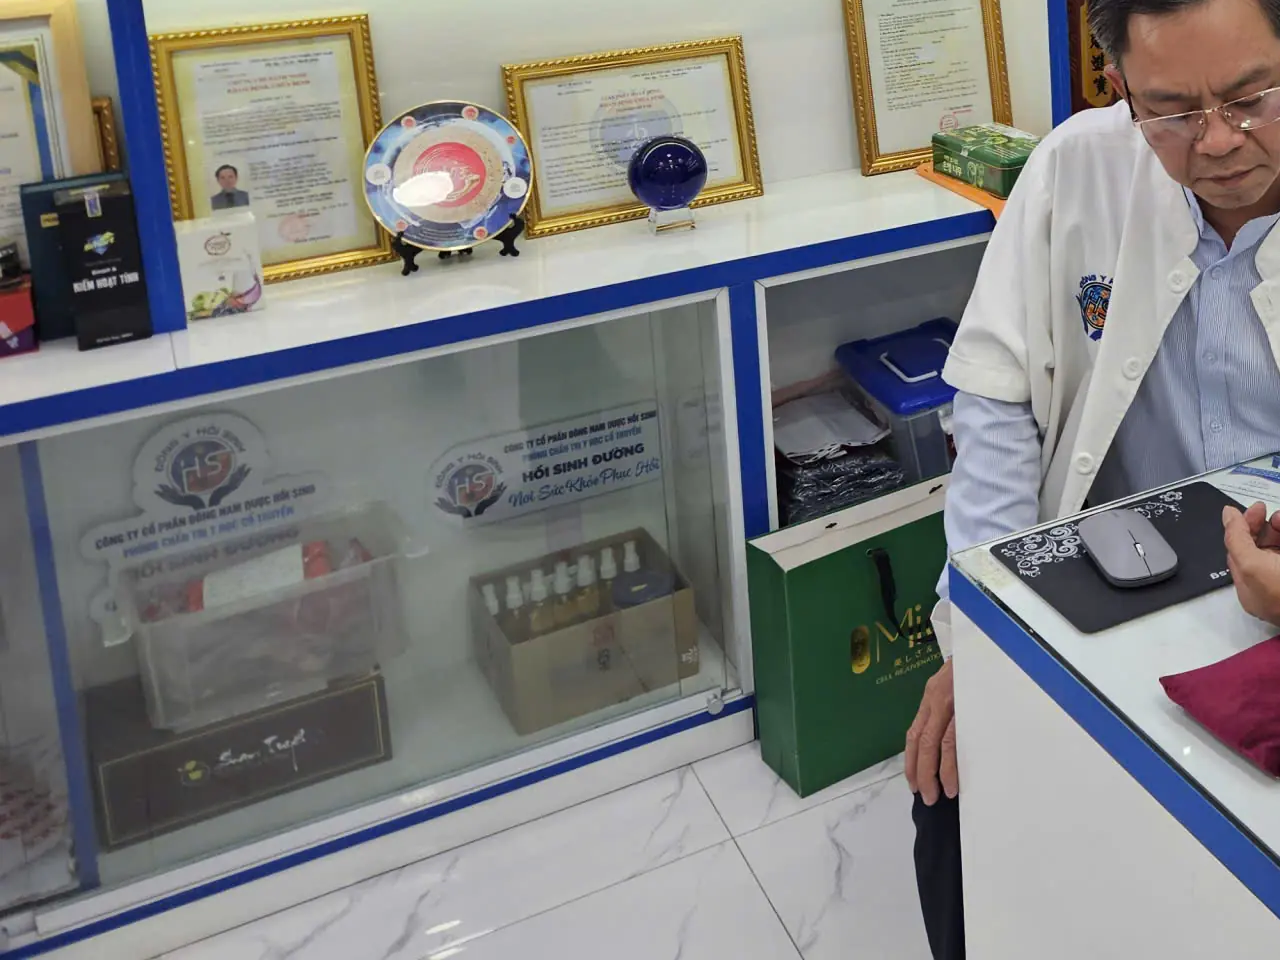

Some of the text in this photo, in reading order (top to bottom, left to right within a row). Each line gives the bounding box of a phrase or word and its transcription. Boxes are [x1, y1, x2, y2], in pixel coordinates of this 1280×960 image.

[504, 442, 524, 454] CÔNG
[525, 439, 535, 449] TY
[536, 434, 546, 446] CỔ
[548, 428, 567, 444] PHẦN
[589, 422, 606, 434] NAM
[522, 443, 645, 483] HỒI SINH ĐƯỜNG
[508, 490, 534, 508] Nơi
[537, 482, 565, 501] Sức
[565, 473, 599, 494] Khỏe
[599, 467, 632, 488] Phục
[95, 537, 125, 551] CÔNG
[126, 531, 141, 543] TY
[141, 522, 156, 538] CỔ
[158, 516, 187, 534] PHẦN
[219, 503, 243, 517] NAM
[876, 651, 943, 685] CELL REJUVENATIO
